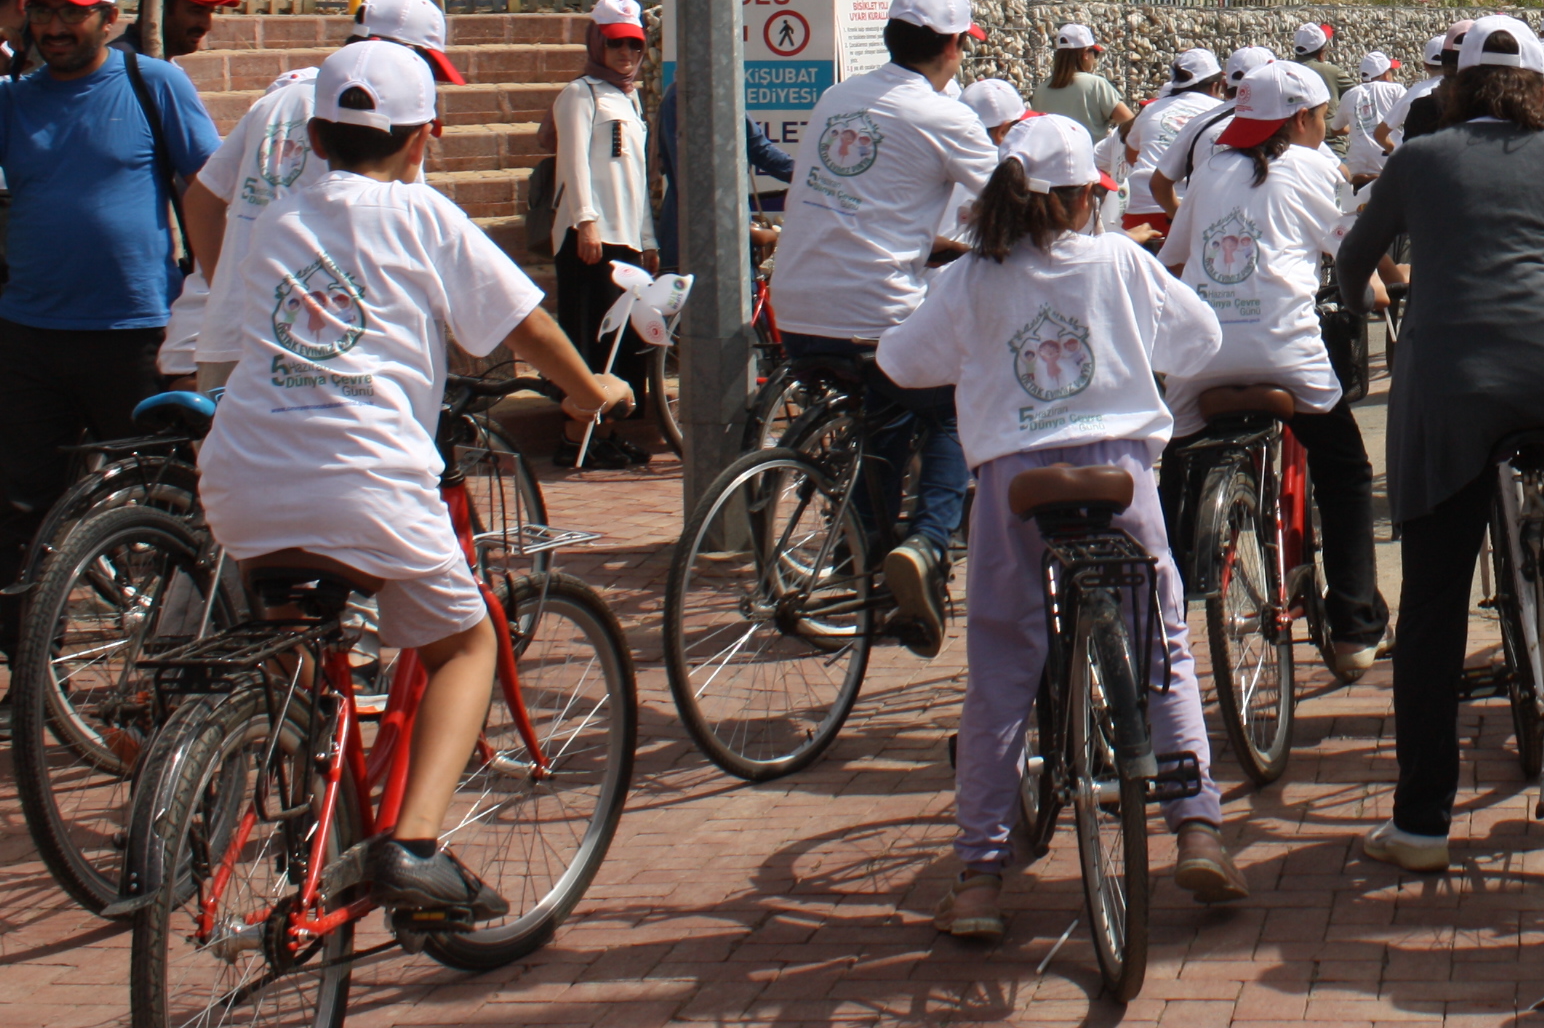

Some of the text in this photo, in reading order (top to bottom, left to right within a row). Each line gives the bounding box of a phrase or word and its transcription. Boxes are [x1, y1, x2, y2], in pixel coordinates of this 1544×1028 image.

[747, 88, 817, 103] EDİYESİ
[806, 166, 820, 187] 5
[1209, 290, 1236, 298] Haziran
[1234, 299, 1261, 308] Çevre
[1240, 308, 1261, 316] Günü
[271, 354, 291, 387] 5
[286, 373, 373, 388] Dünya Çevre
[341, 385, 375, 397] Günü
[1019, 406, 1035, 430] 5
[1034, 406, 1068, 419] Haziran
[1029, 413, 1103, 431] Dünya Çevre
